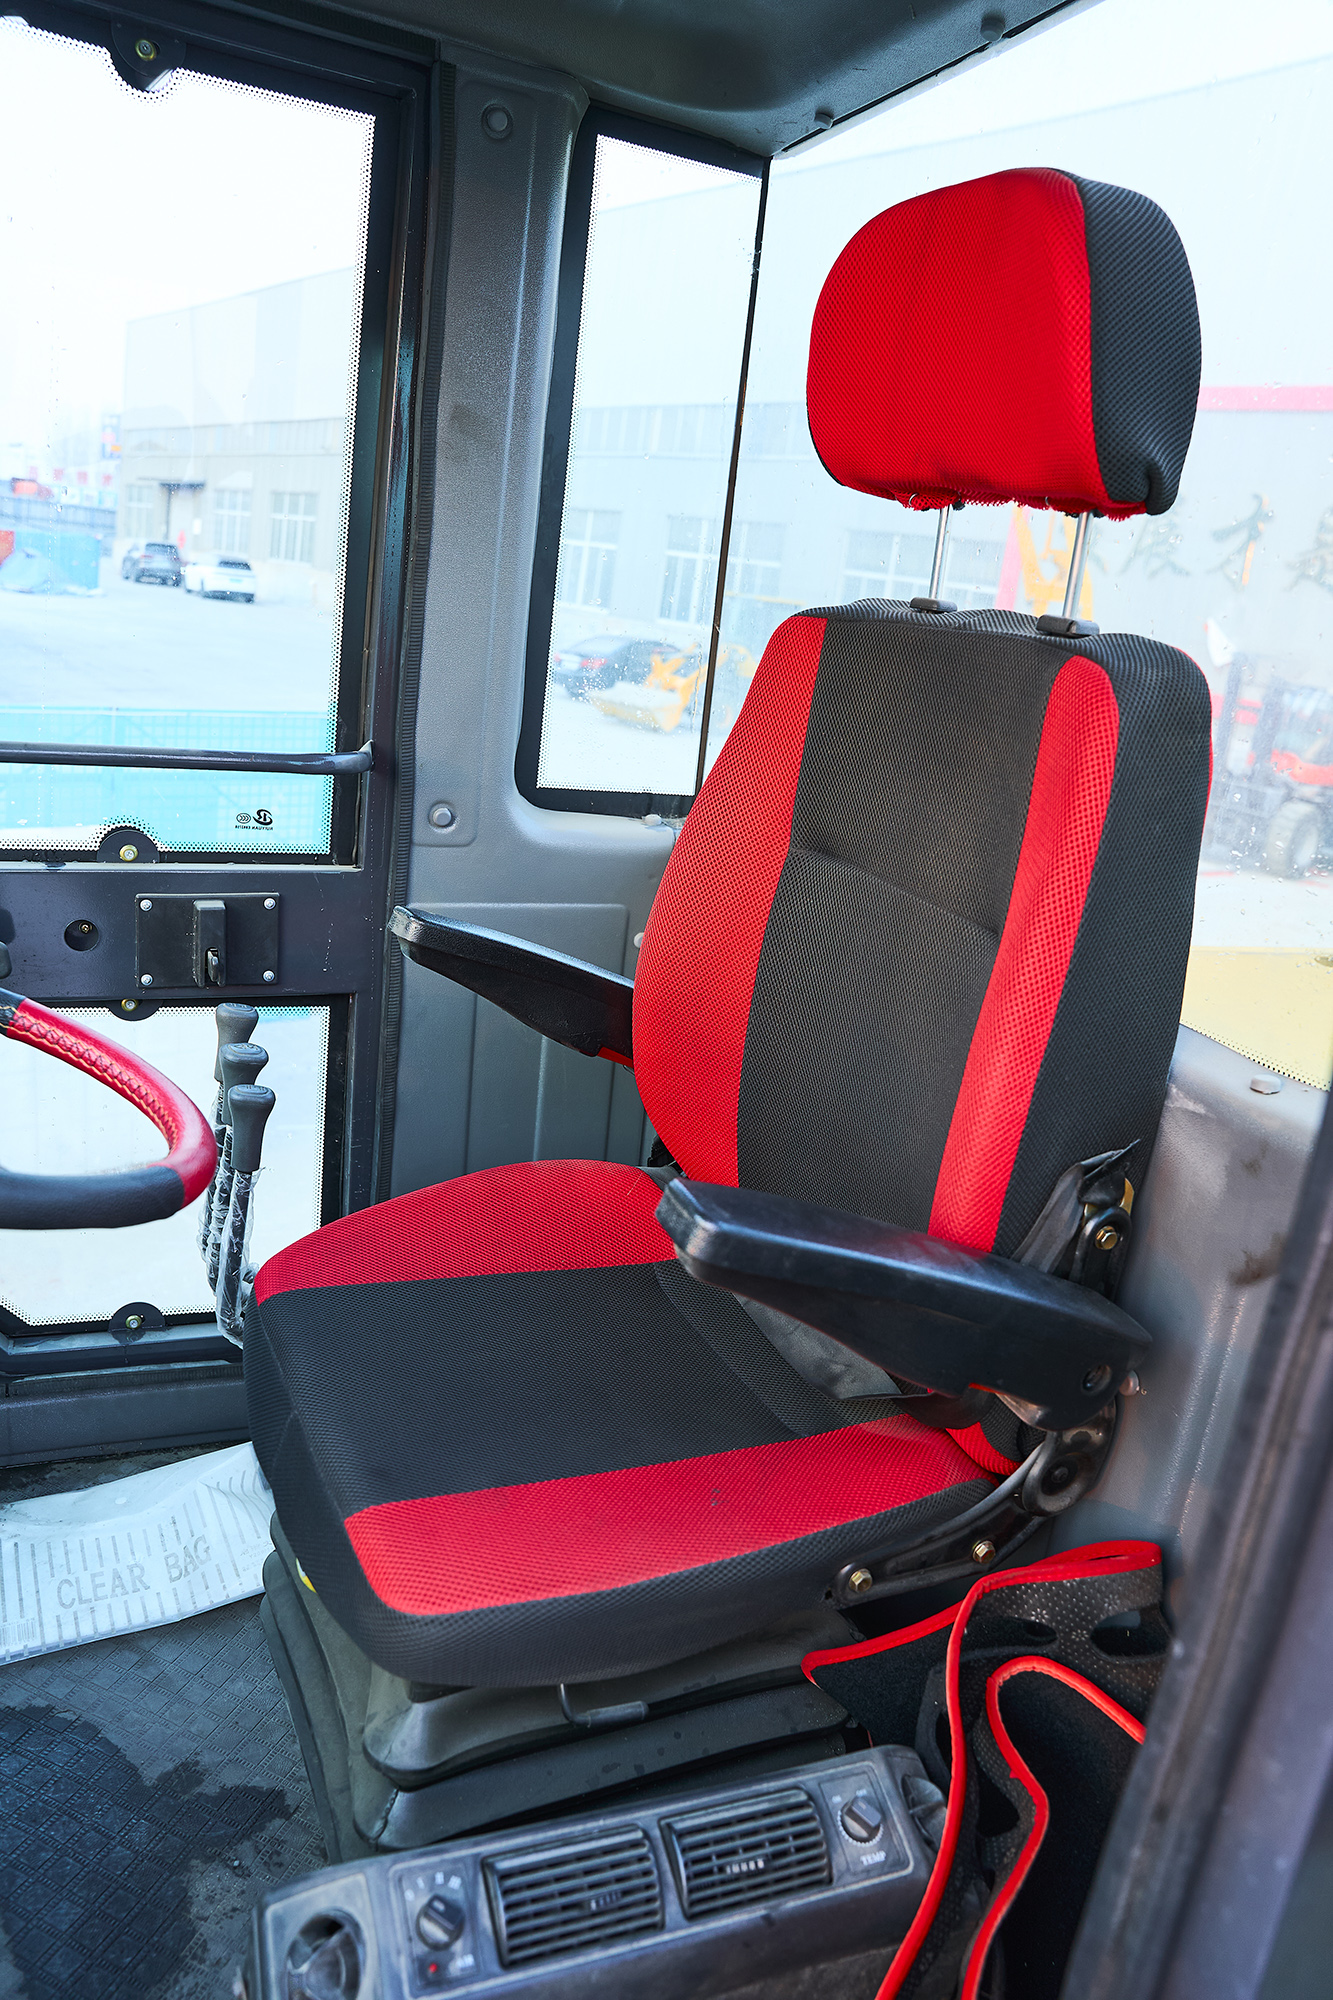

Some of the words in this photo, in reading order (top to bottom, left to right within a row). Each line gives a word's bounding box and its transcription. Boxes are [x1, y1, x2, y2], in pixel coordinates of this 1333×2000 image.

[56, 1562, 151, 1610] CLEAR
[163, 1534, 212, 1584] BAG
[860, 1850, 886, 1866] TEMP
